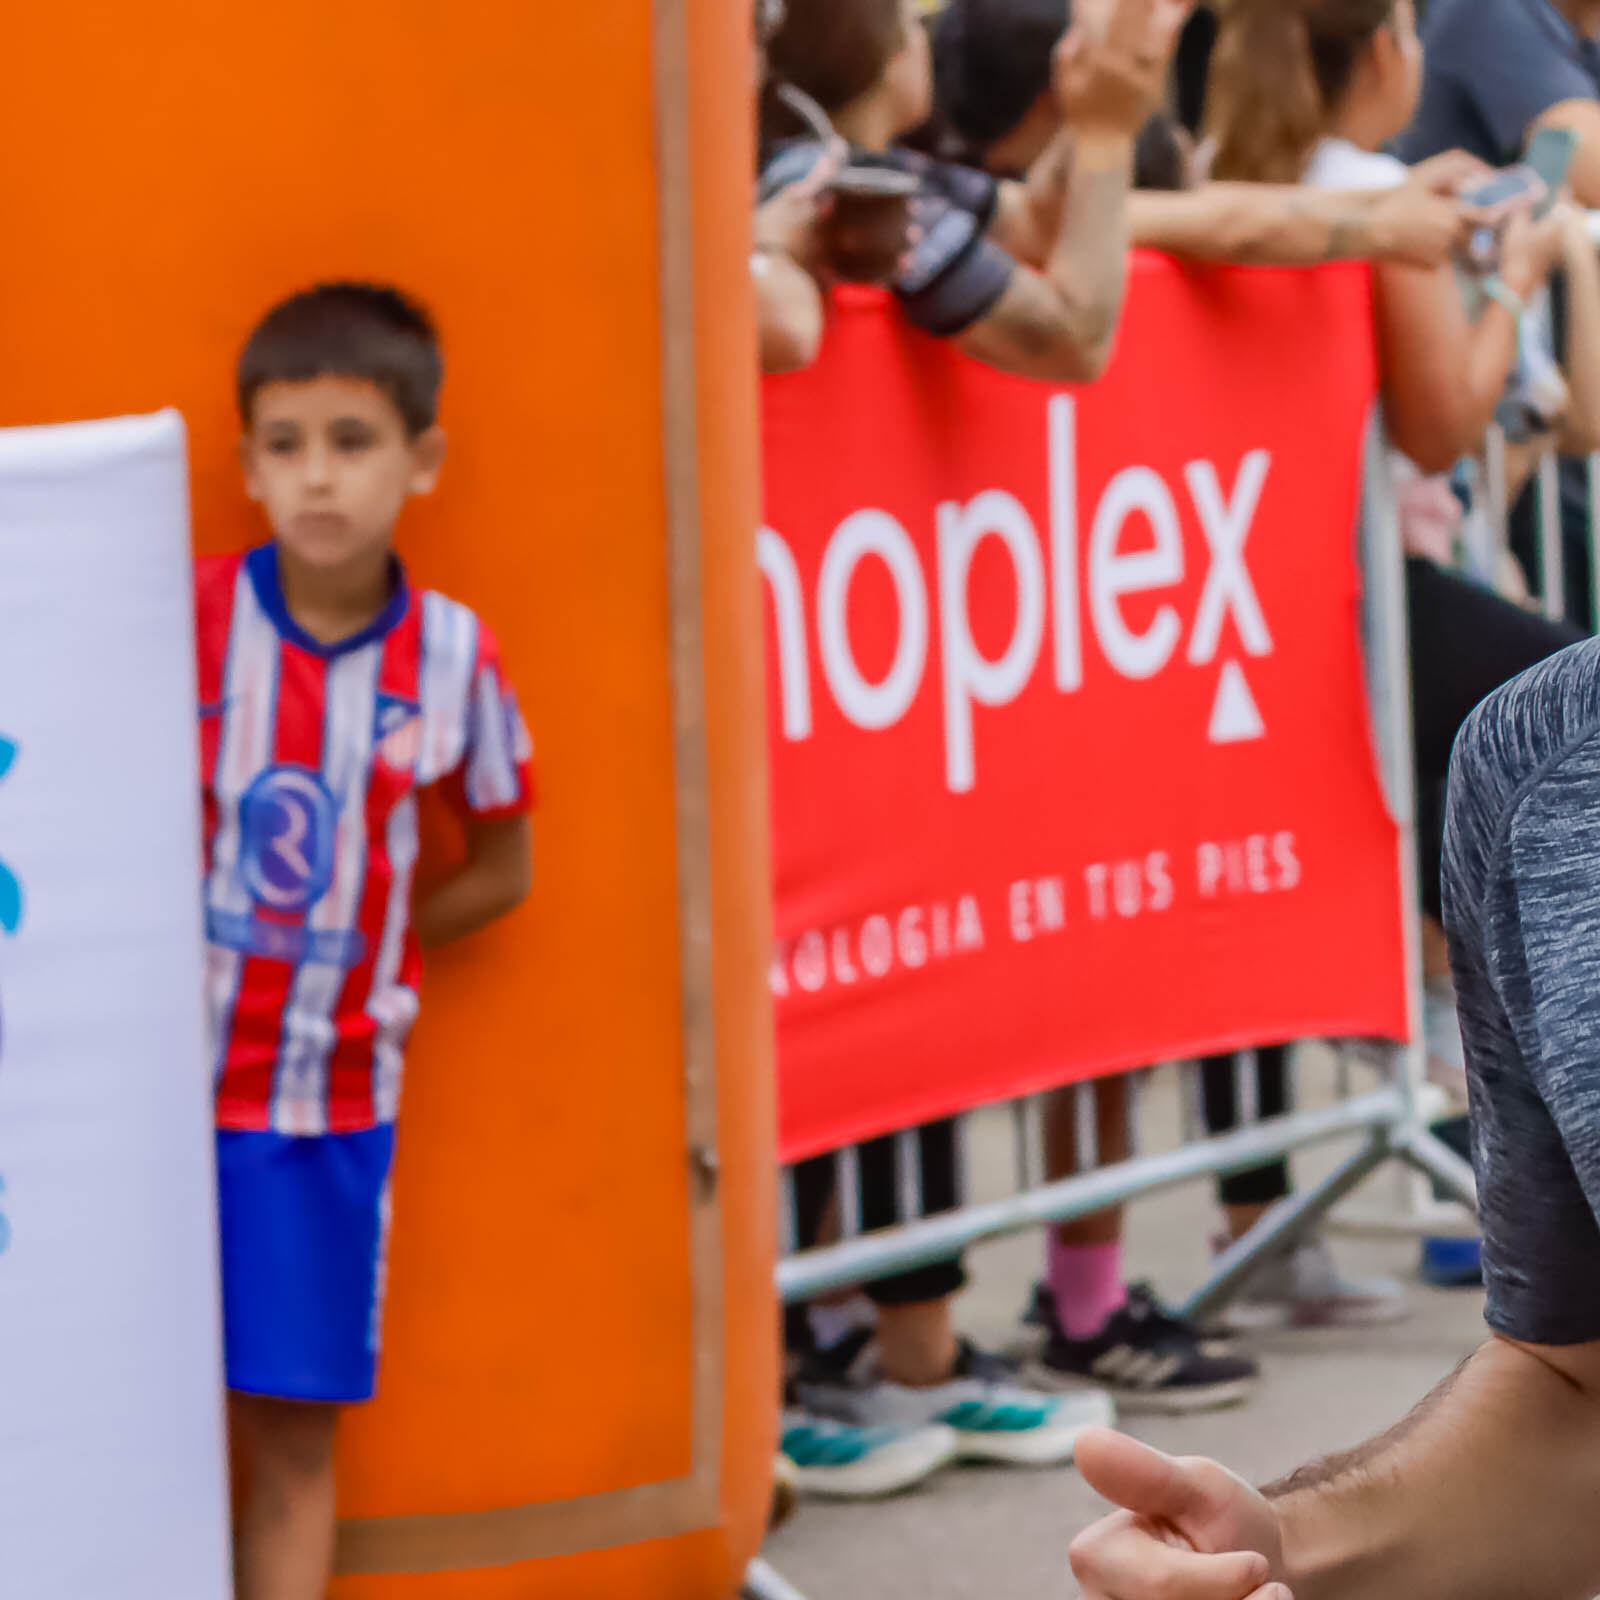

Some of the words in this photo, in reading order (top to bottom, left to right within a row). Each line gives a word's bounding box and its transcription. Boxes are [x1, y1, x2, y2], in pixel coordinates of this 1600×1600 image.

[1009, 876, 1066, 942] EN
[1084, 849, 1175, 920] TUS
[1196, 829, 1301, 897] PIES
